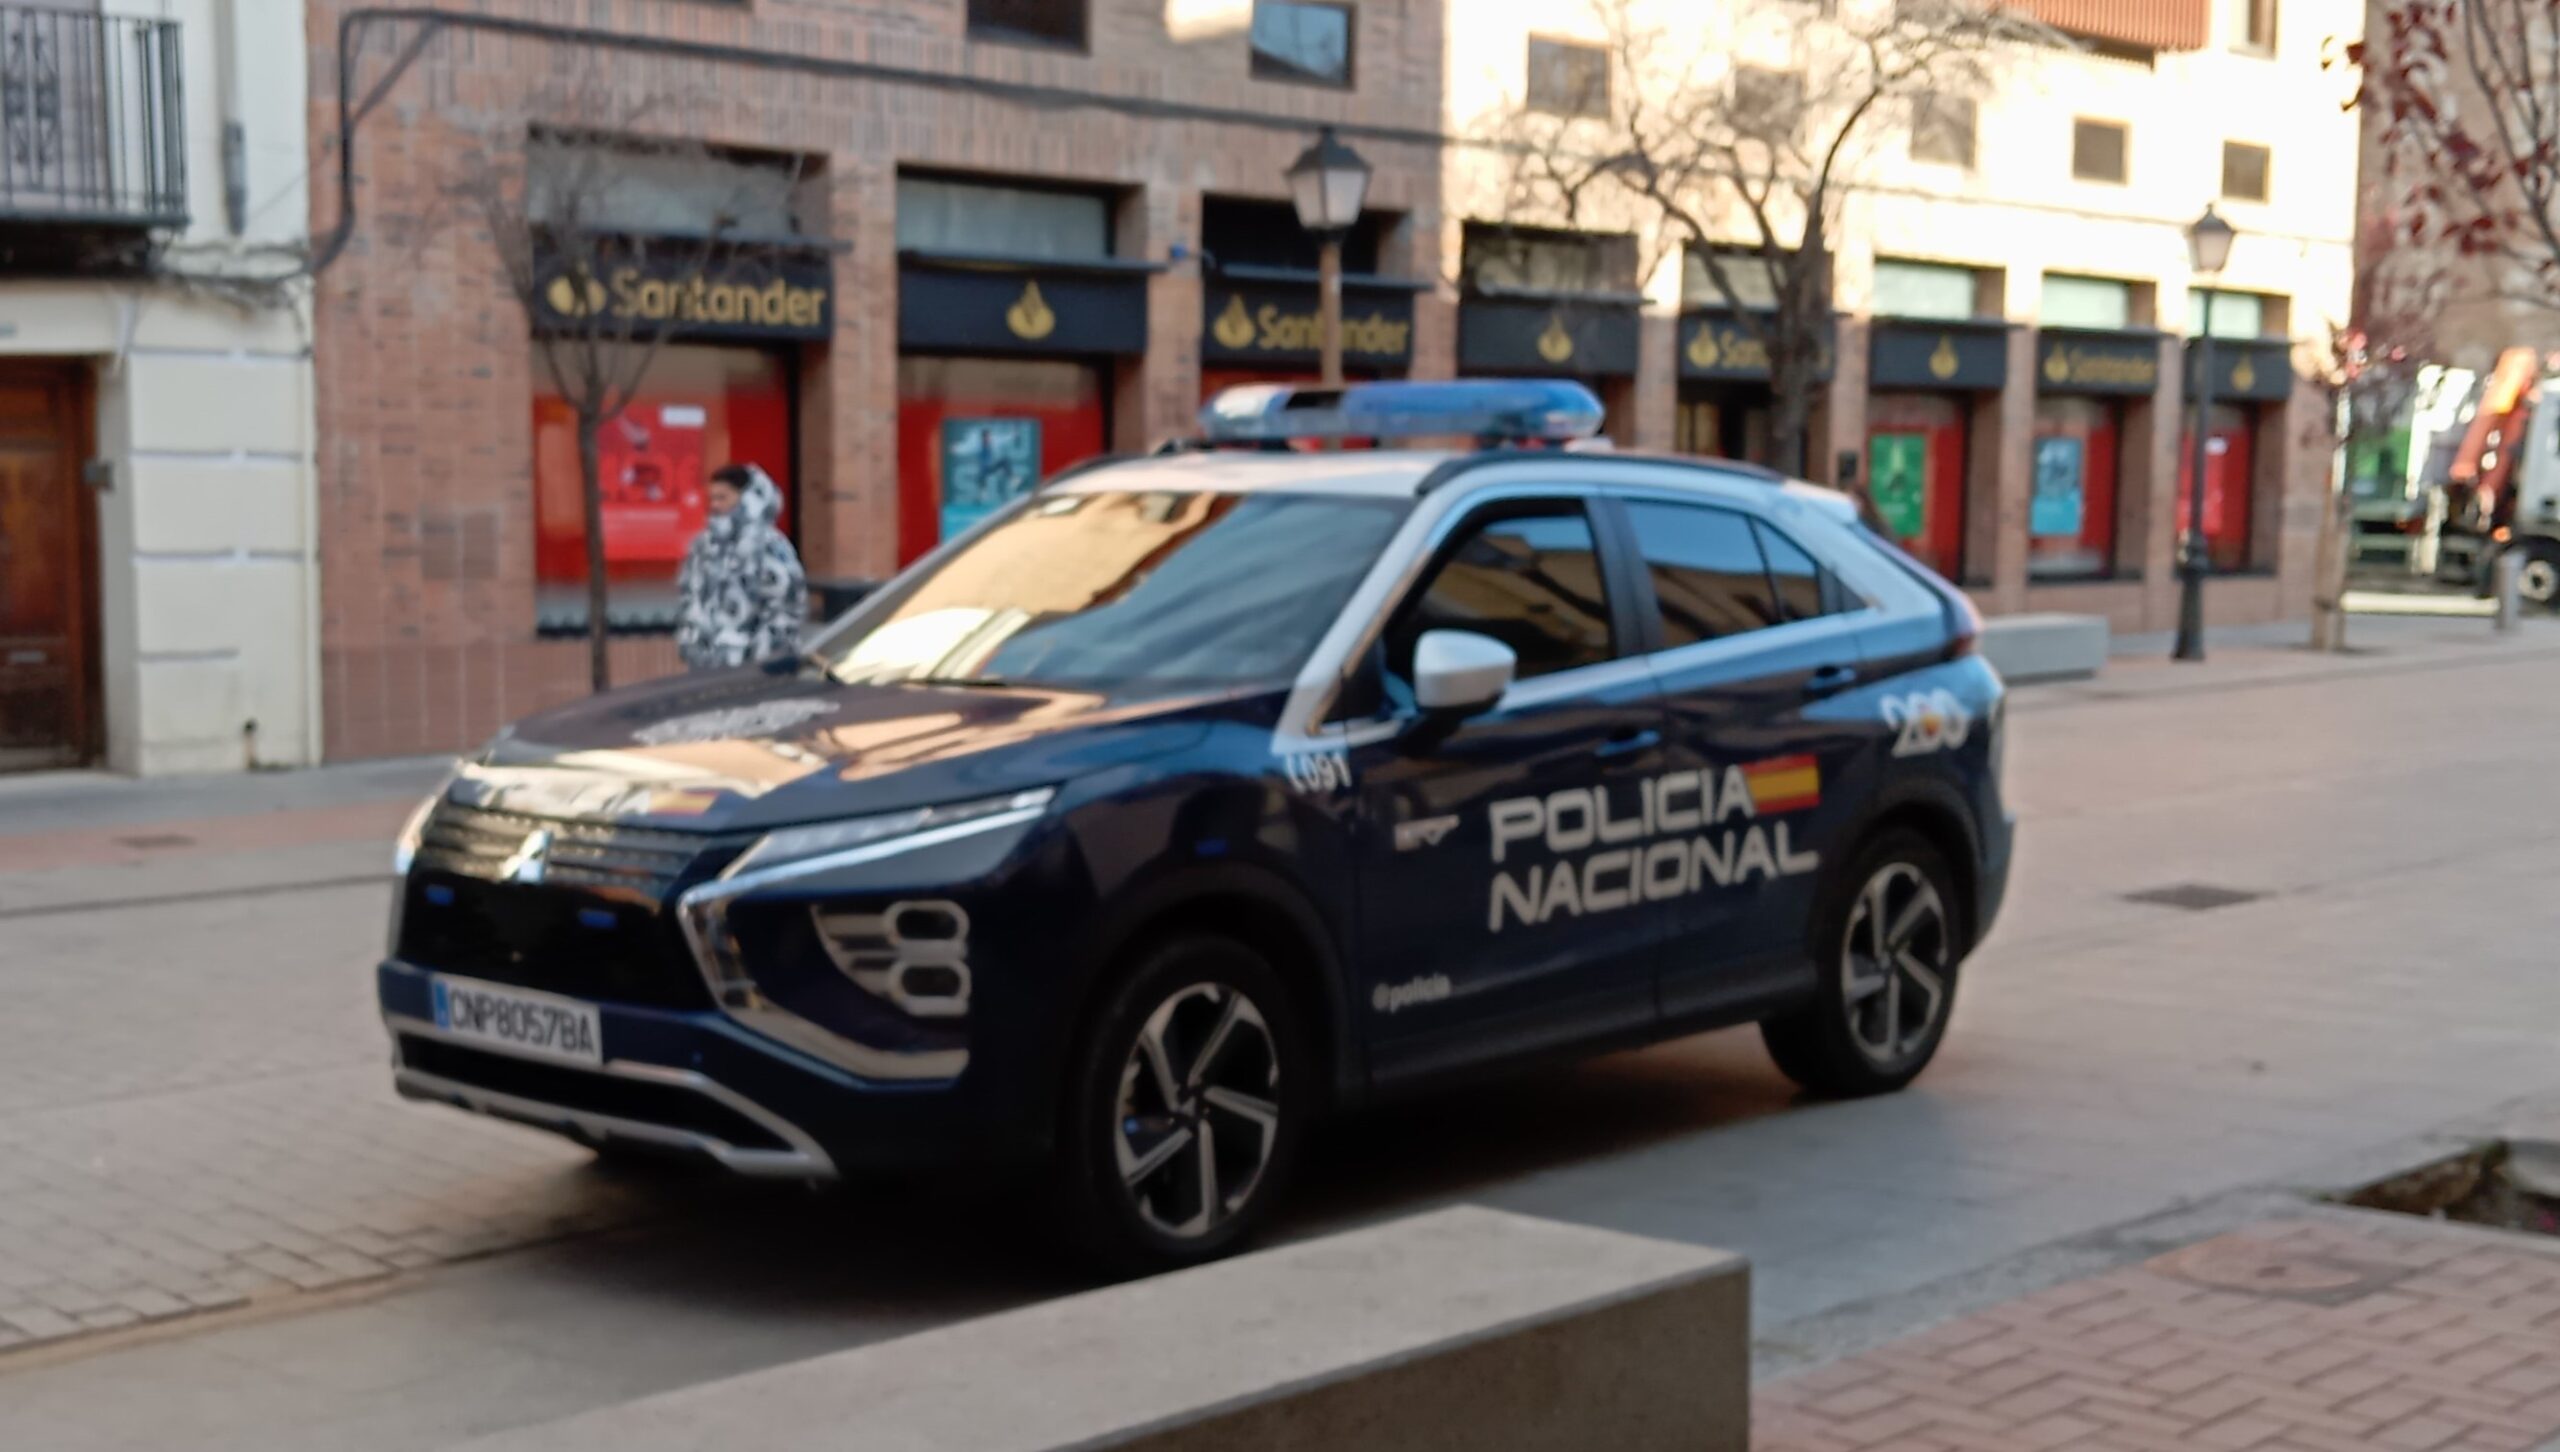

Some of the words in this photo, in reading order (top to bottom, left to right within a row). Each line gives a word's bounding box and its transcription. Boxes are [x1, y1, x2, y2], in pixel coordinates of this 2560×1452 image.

[611, 267, 826, 326] Santander
[1489, 764, 1756, 863] POLICIA
[1489, 820, 1819, 933] NACIONAL
[452, 988, 595, 1055] CNP8057BA
